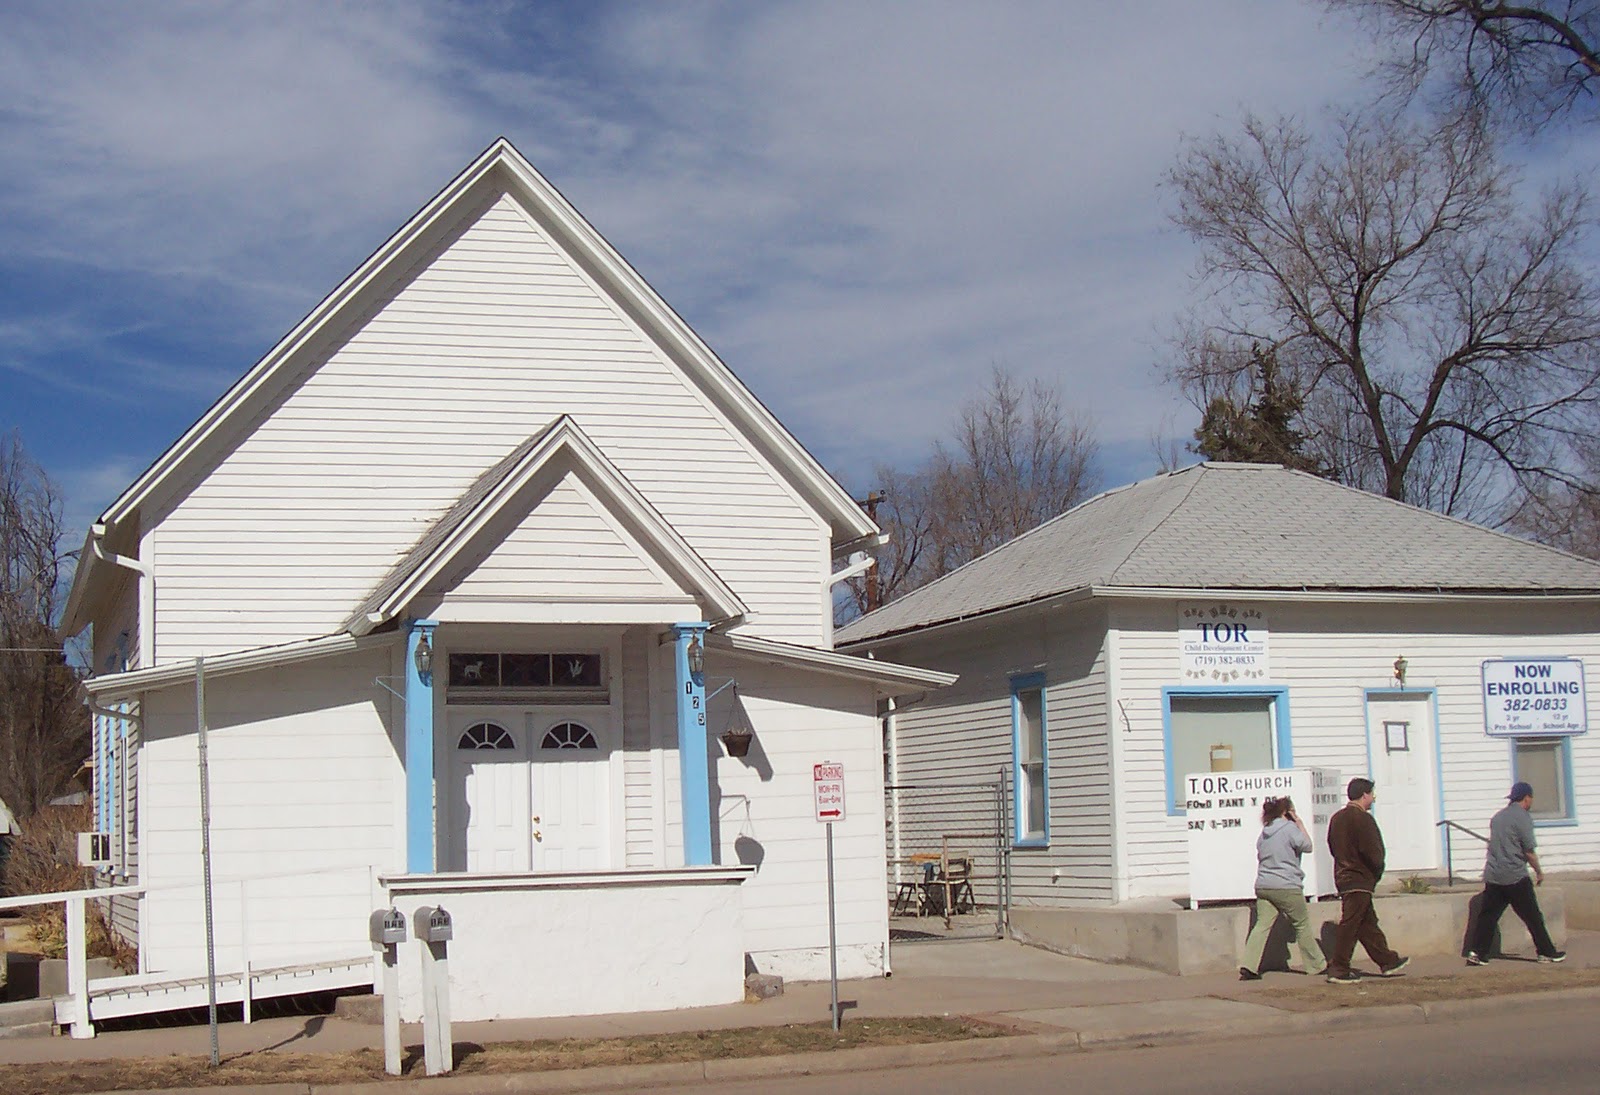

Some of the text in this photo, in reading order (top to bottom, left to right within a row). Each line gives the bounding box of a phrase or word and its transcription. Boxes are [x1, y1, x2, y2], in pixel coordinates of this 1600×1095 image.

[1196, 622, 1249, 643] TOR
[1184, 644, 1264, 653] Child Development Center
[1194, 656, 1256, 666] (719) 382-0833
[1514, 665, 1552, 678] NOW
[1487, 681, 1580, 696] ENROLLING
[1503, 698, 1567, 711] 382-0833
[1508, 723, 1532, 731] School
[1188, 777, 1293, 795] T.O.R. CHURCH
